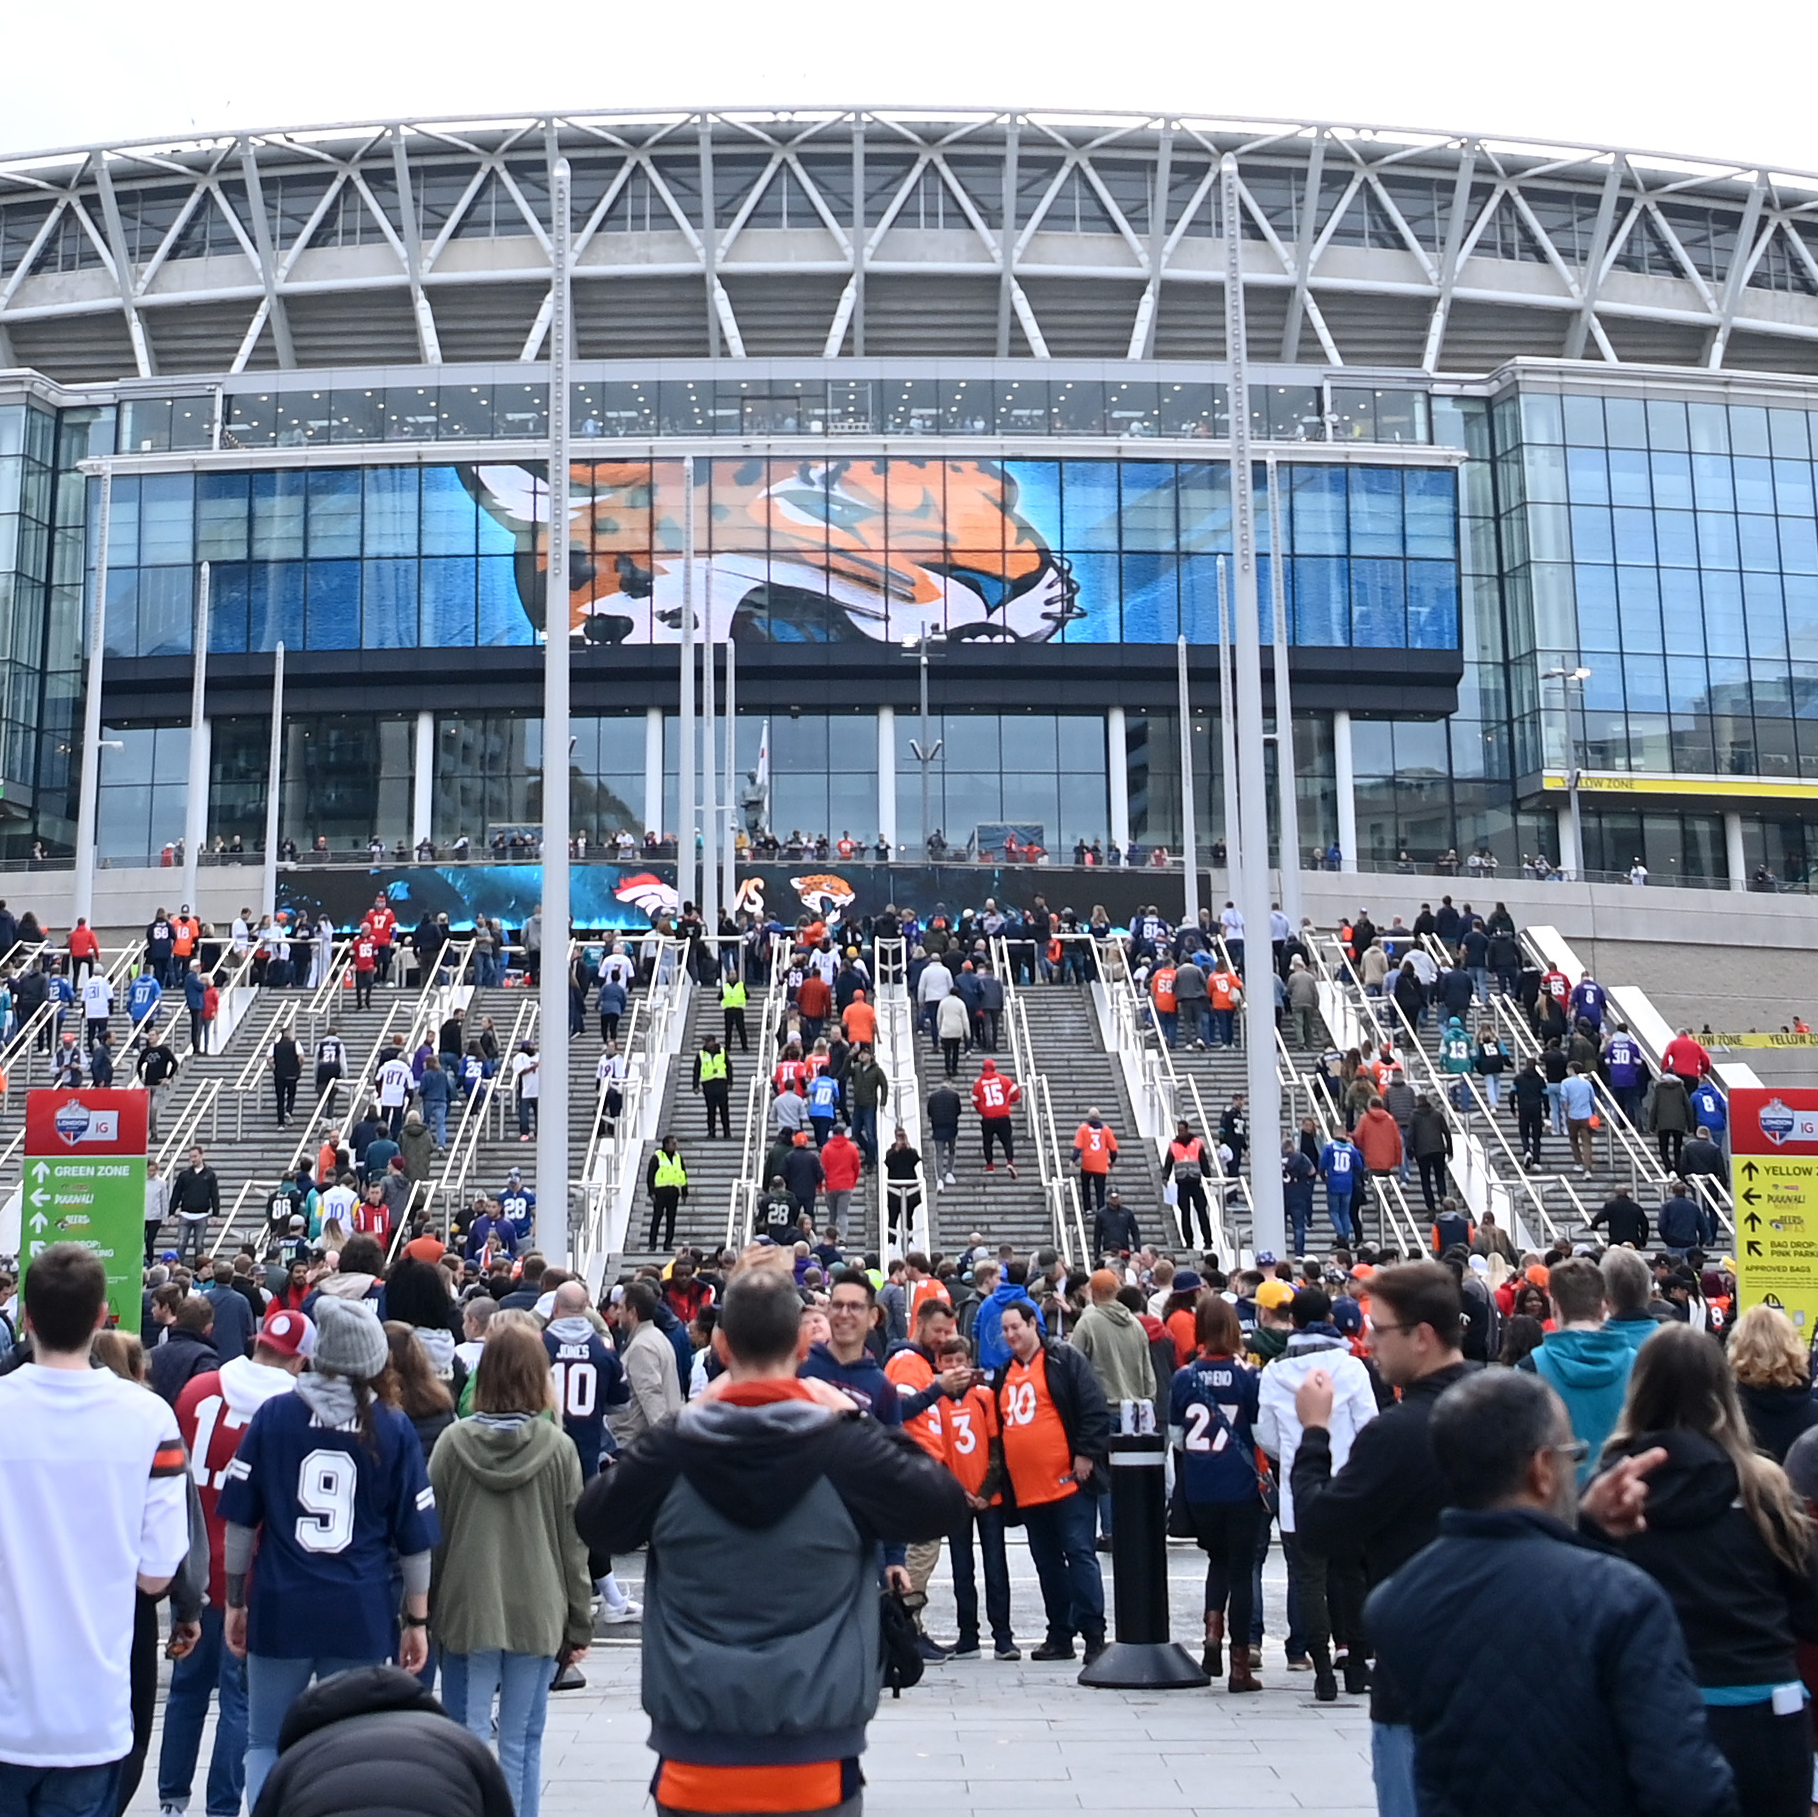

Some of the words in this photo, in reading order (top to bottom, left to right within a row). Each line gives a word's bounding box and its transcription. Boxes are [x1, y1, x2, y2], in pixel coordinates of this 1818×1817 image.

[1604, 777, 1636, 790] ZONE
[135, 986, 148, 1003] 97
[1586, 990, 1594, 1004] 8
[1716, 1035, 1743, 1046] ZONE
[1769, 1033, 1807, 1045] YELLOW
[1449, 1041, 1467, 1059] 13
[1612, 1048, 1630, 1065] 30
[386, 1070, 403, 1085] 87
[816, 1087, 832, 1104] 10
[983, 1083, 1004, 1107] 15
[1702, 1095, 1715, 1113] 8
[95, 1122, 109, 1134] IG
[1800, 1122, 1814, 1134] IG
[1090, 1133, 1101, 1151] 3
[1333, 1151, 1350, 1172] 10
[54, 1166, 95, 1177] GREEN
[97, 1166, 130, 1177] ZONE
[1764, 1166, 1813, 1176] YELLOW
[272, 1199, 291, 1220] 86
[503, 1197, 527, 1220] 28
[767, 1203, 790, 1226] 28
[374, 1215, 383, 1234] 11
[1789, 1265, 1811, 1273] BAGS
[556, 1344, 590, 1359] JONES
[552, 1362, 598, 1416] 10
[1000, 1381, 1037, 1427] 10
[951, 1414, 976, 1455] 3
[1185, 1403, 1239, 1452] 27
[294, 1448, 357, 1554] 9
